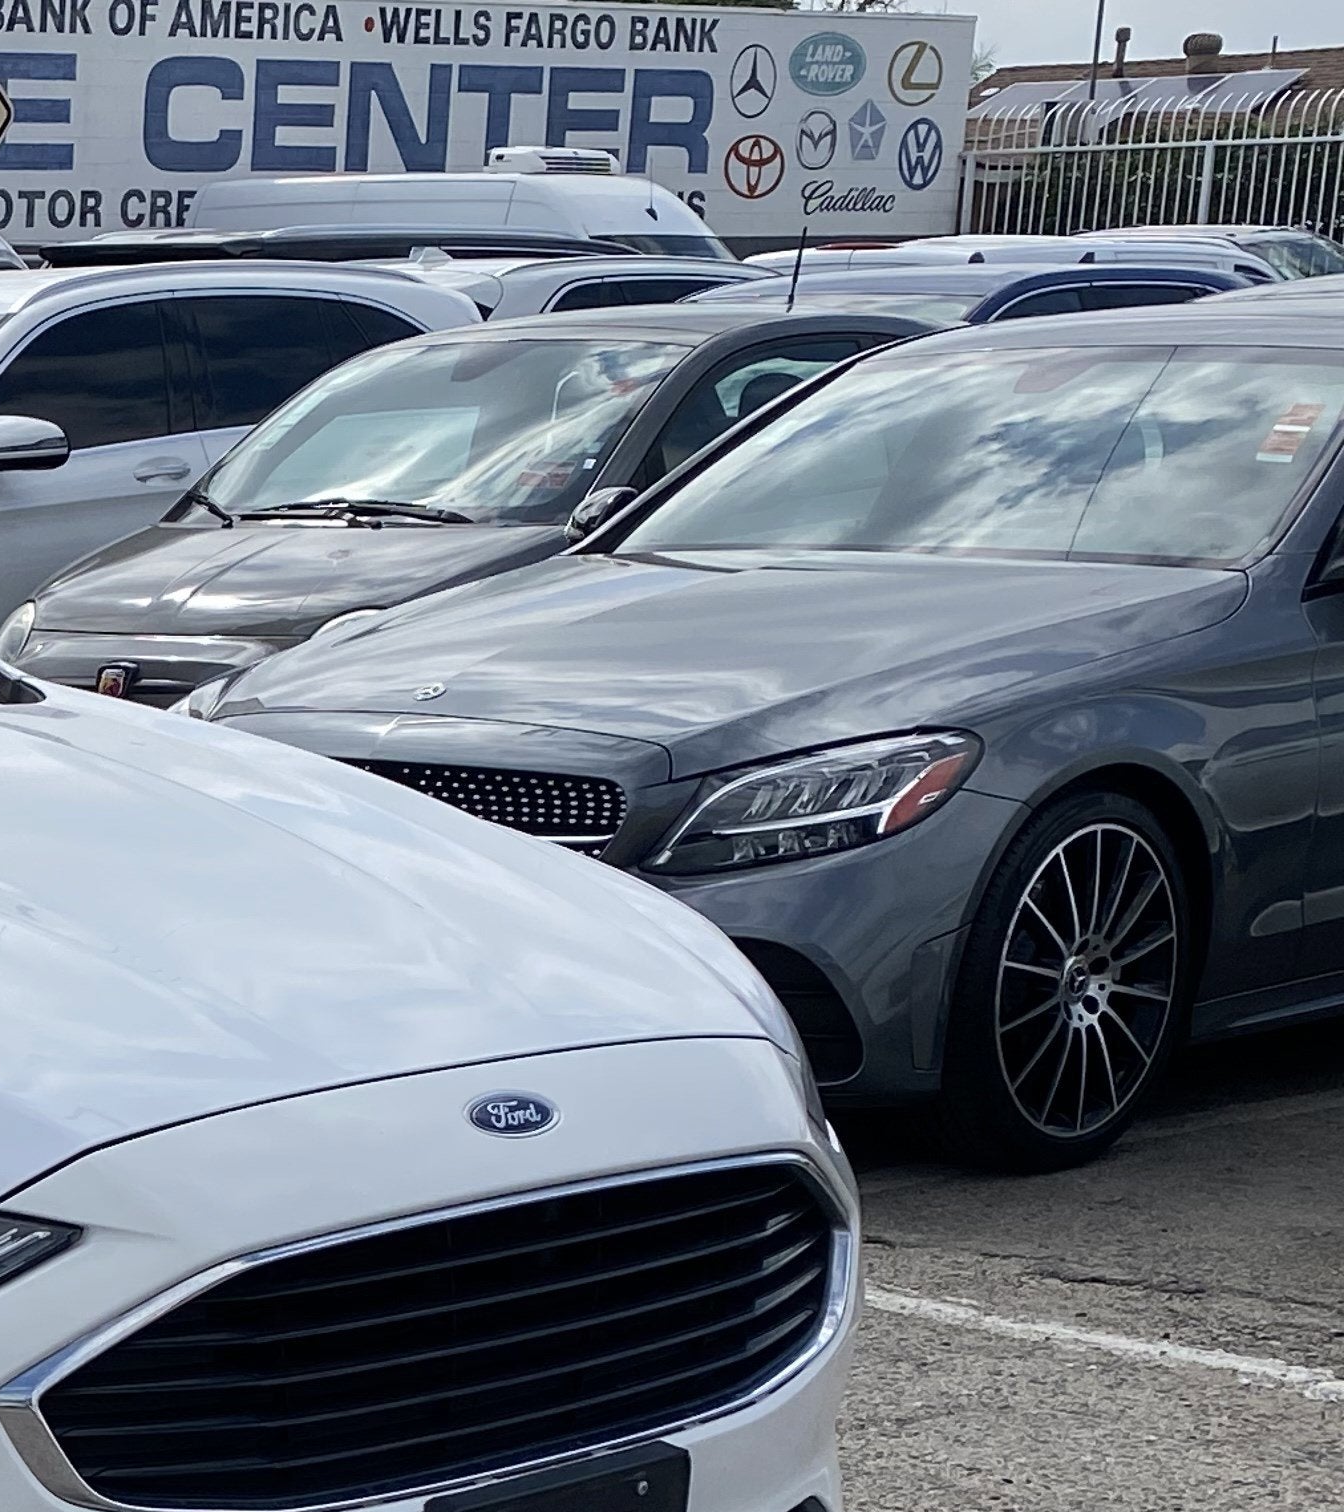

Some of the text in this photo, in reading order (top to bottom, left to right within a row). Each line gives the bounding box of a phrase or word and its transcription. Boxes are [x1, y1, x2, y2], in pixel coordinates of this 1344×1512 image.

[109, 0, 159, 36] OF
[168, 0, 343, 42] AMERICA
[379, 7, 492, 46] WELLS
[504, 11, 616, 50] FARGO
[629, 15, 720, 53] BANK
[805, 44, 843, 63] LAND
[807, 63, 854, 82] ROVER
[143, 55, 714, 175] CENTER
[801, 180, 895, 215] Cadillac
[486, 1100, 542, 1128] Ford
